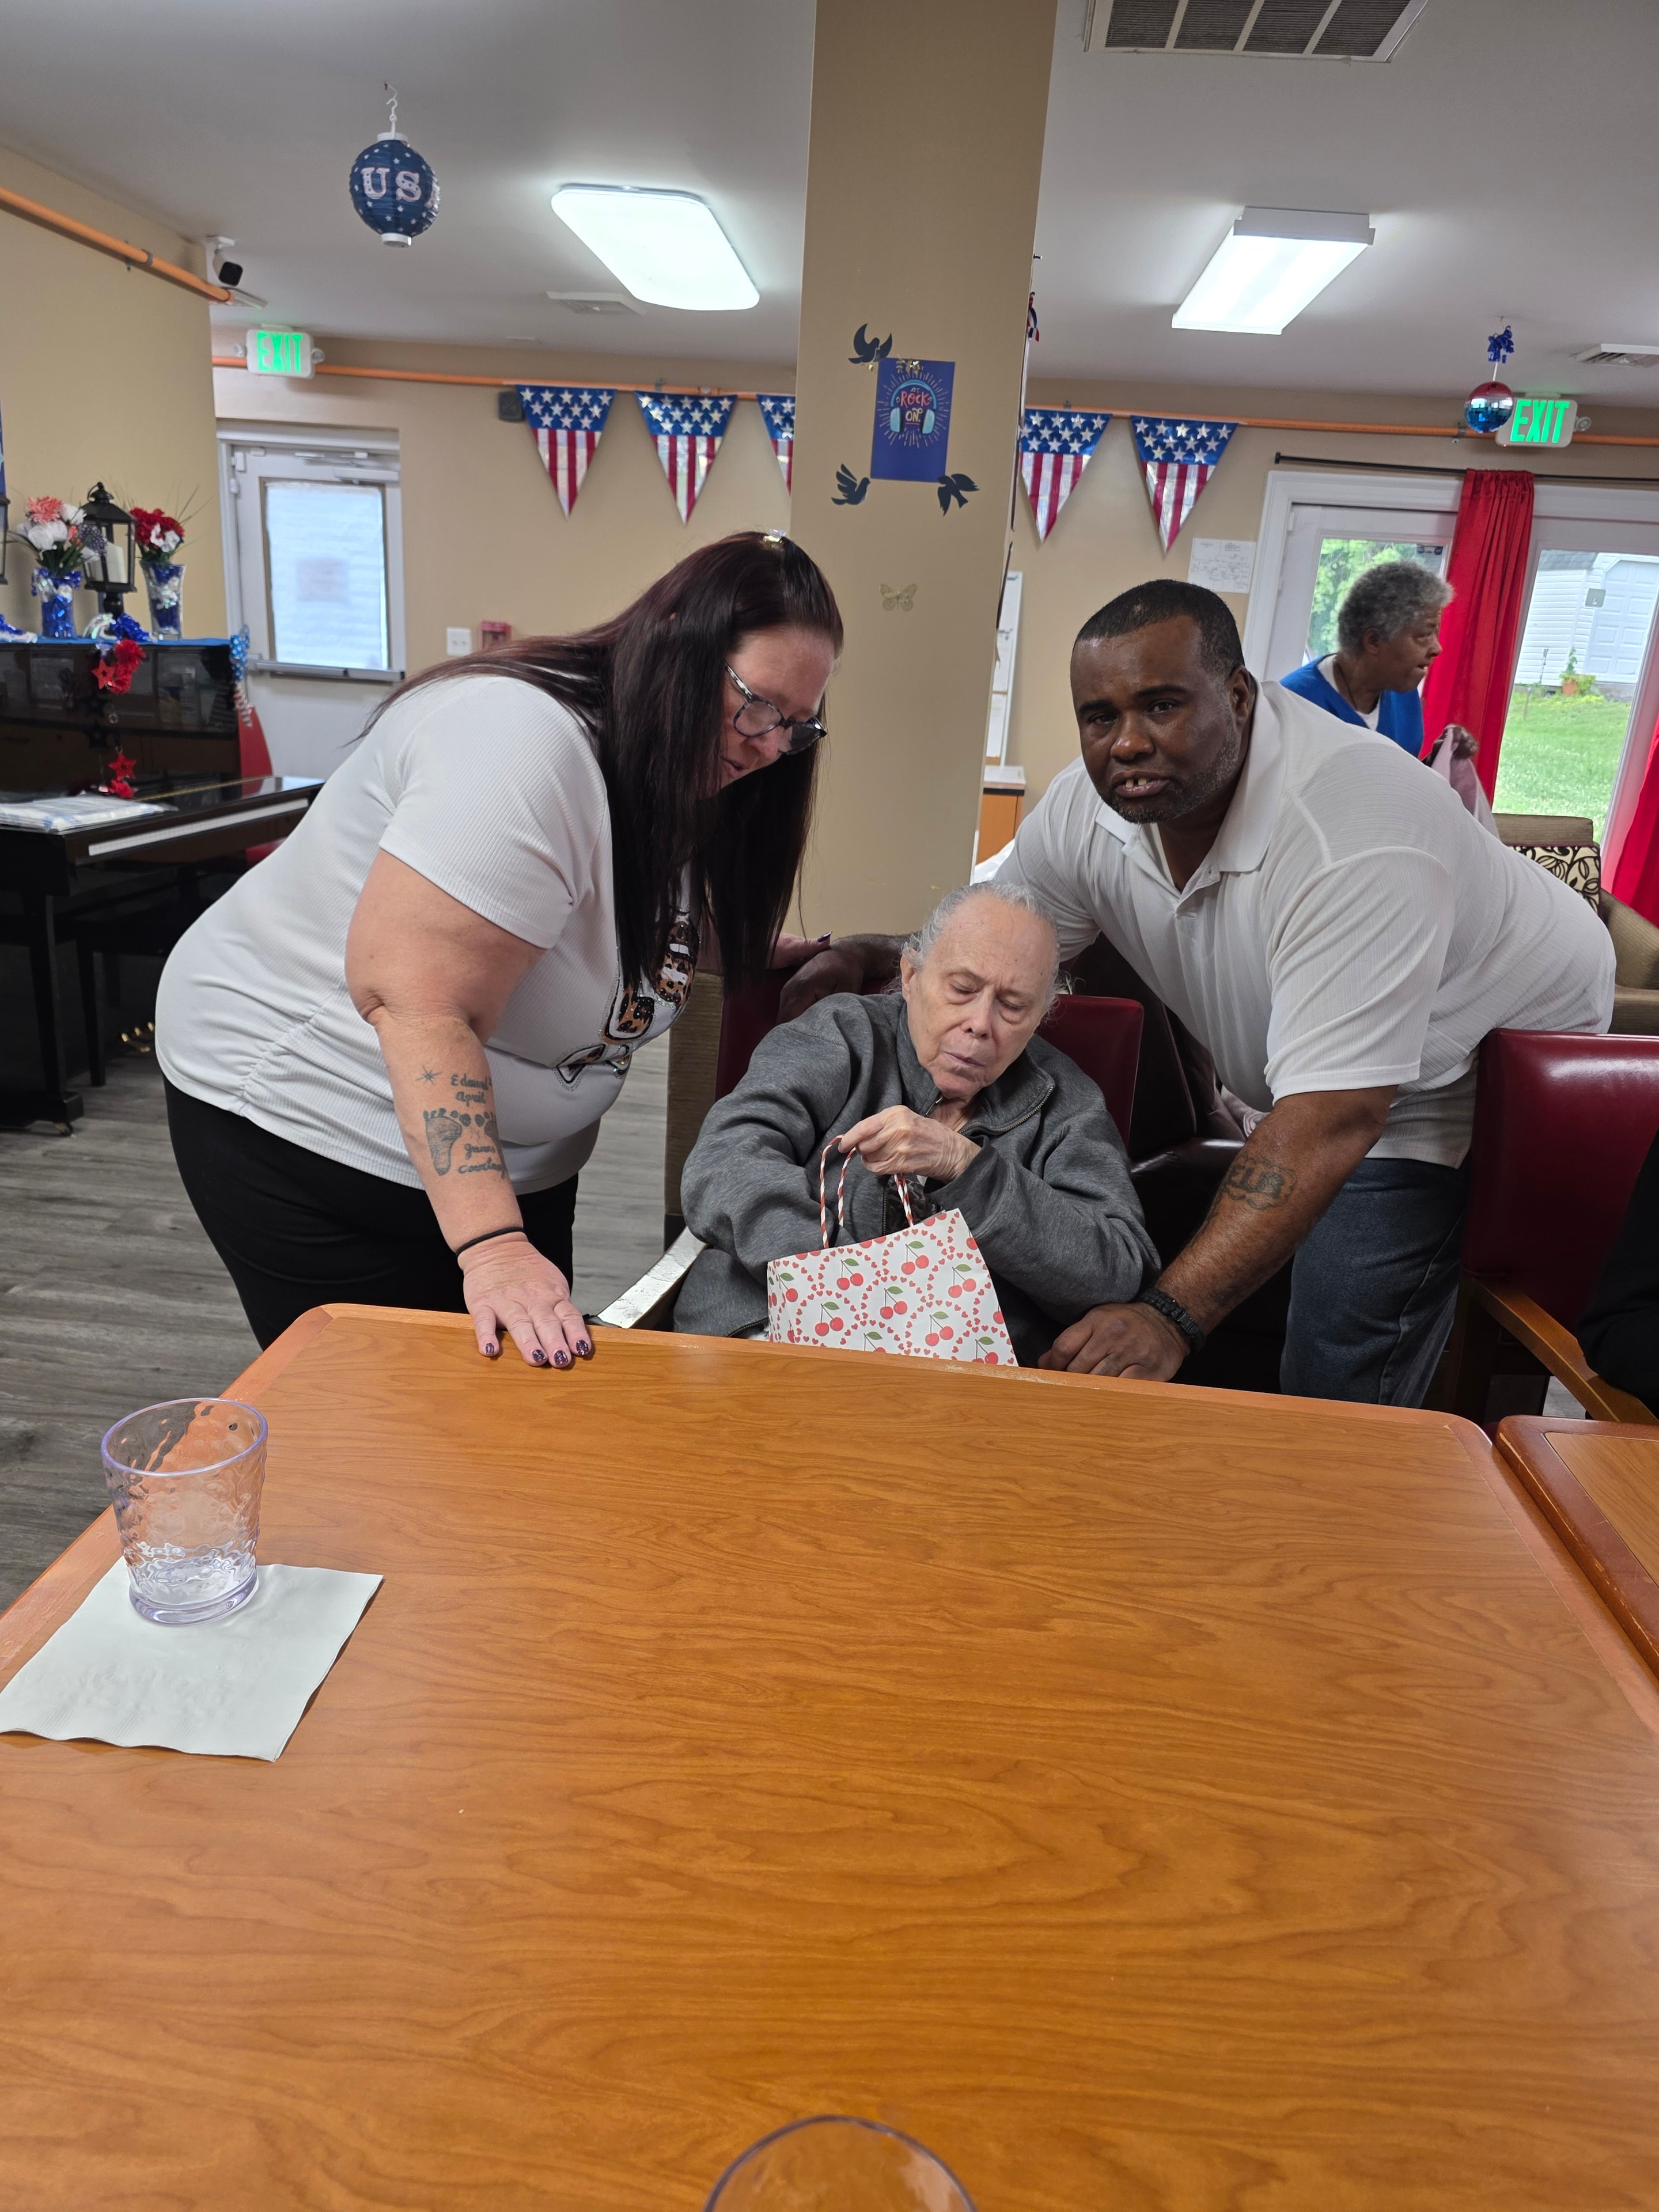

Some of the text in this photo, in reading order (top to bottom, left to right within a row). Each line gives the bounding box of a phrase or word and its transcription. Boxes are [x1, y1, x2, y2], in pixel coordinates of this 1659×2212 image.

[256, 331, 303, 374] EXIT
[900, 391, 930, 408] ROCK
[1510, 399, 1571, 444] EXIT
